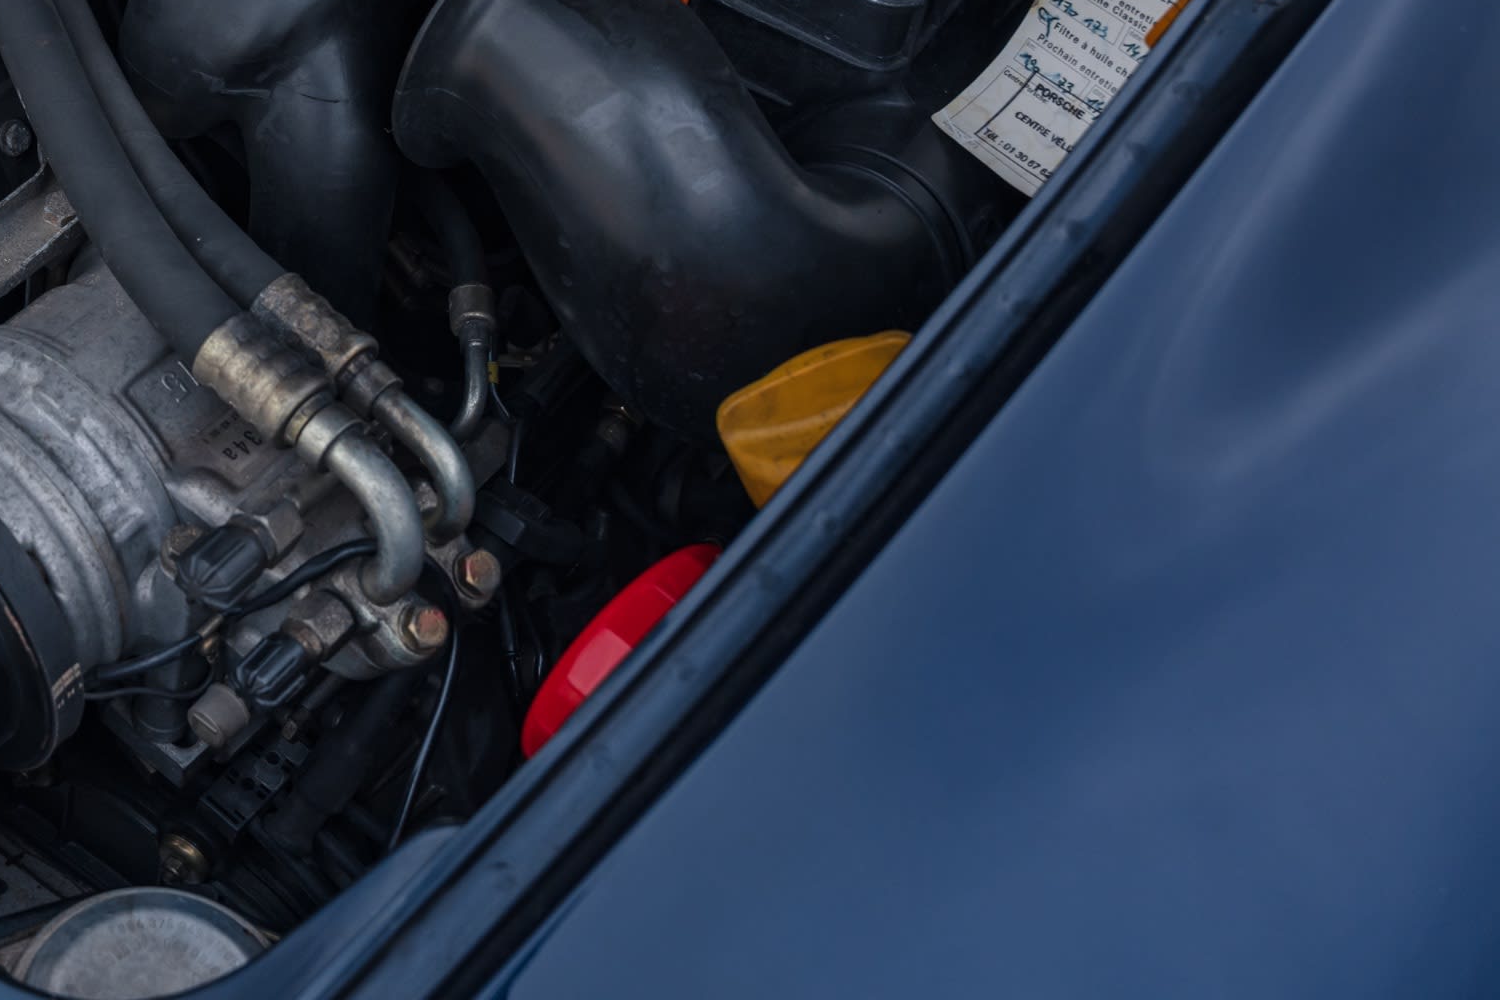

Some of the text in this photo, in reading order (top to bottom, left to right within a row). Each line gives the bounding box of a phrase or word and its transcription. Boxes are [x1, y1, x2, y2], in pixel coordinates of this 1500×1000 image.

[1112, 5, 1147, 32] Classic
[1038, 34, 1077, 66] Prochain
[1054, 22, 1080, 44] Filtre
[1082, 41, 1088, 50] à
[1090, 47, 1113, 68] huile
[1035, 84, 1085, 120] PORSCHE
[1015, 112, 1051, 137] CENTRE
[1013, 150, 1028, 162] 30
[1027, 159, 1041, 169] 67
